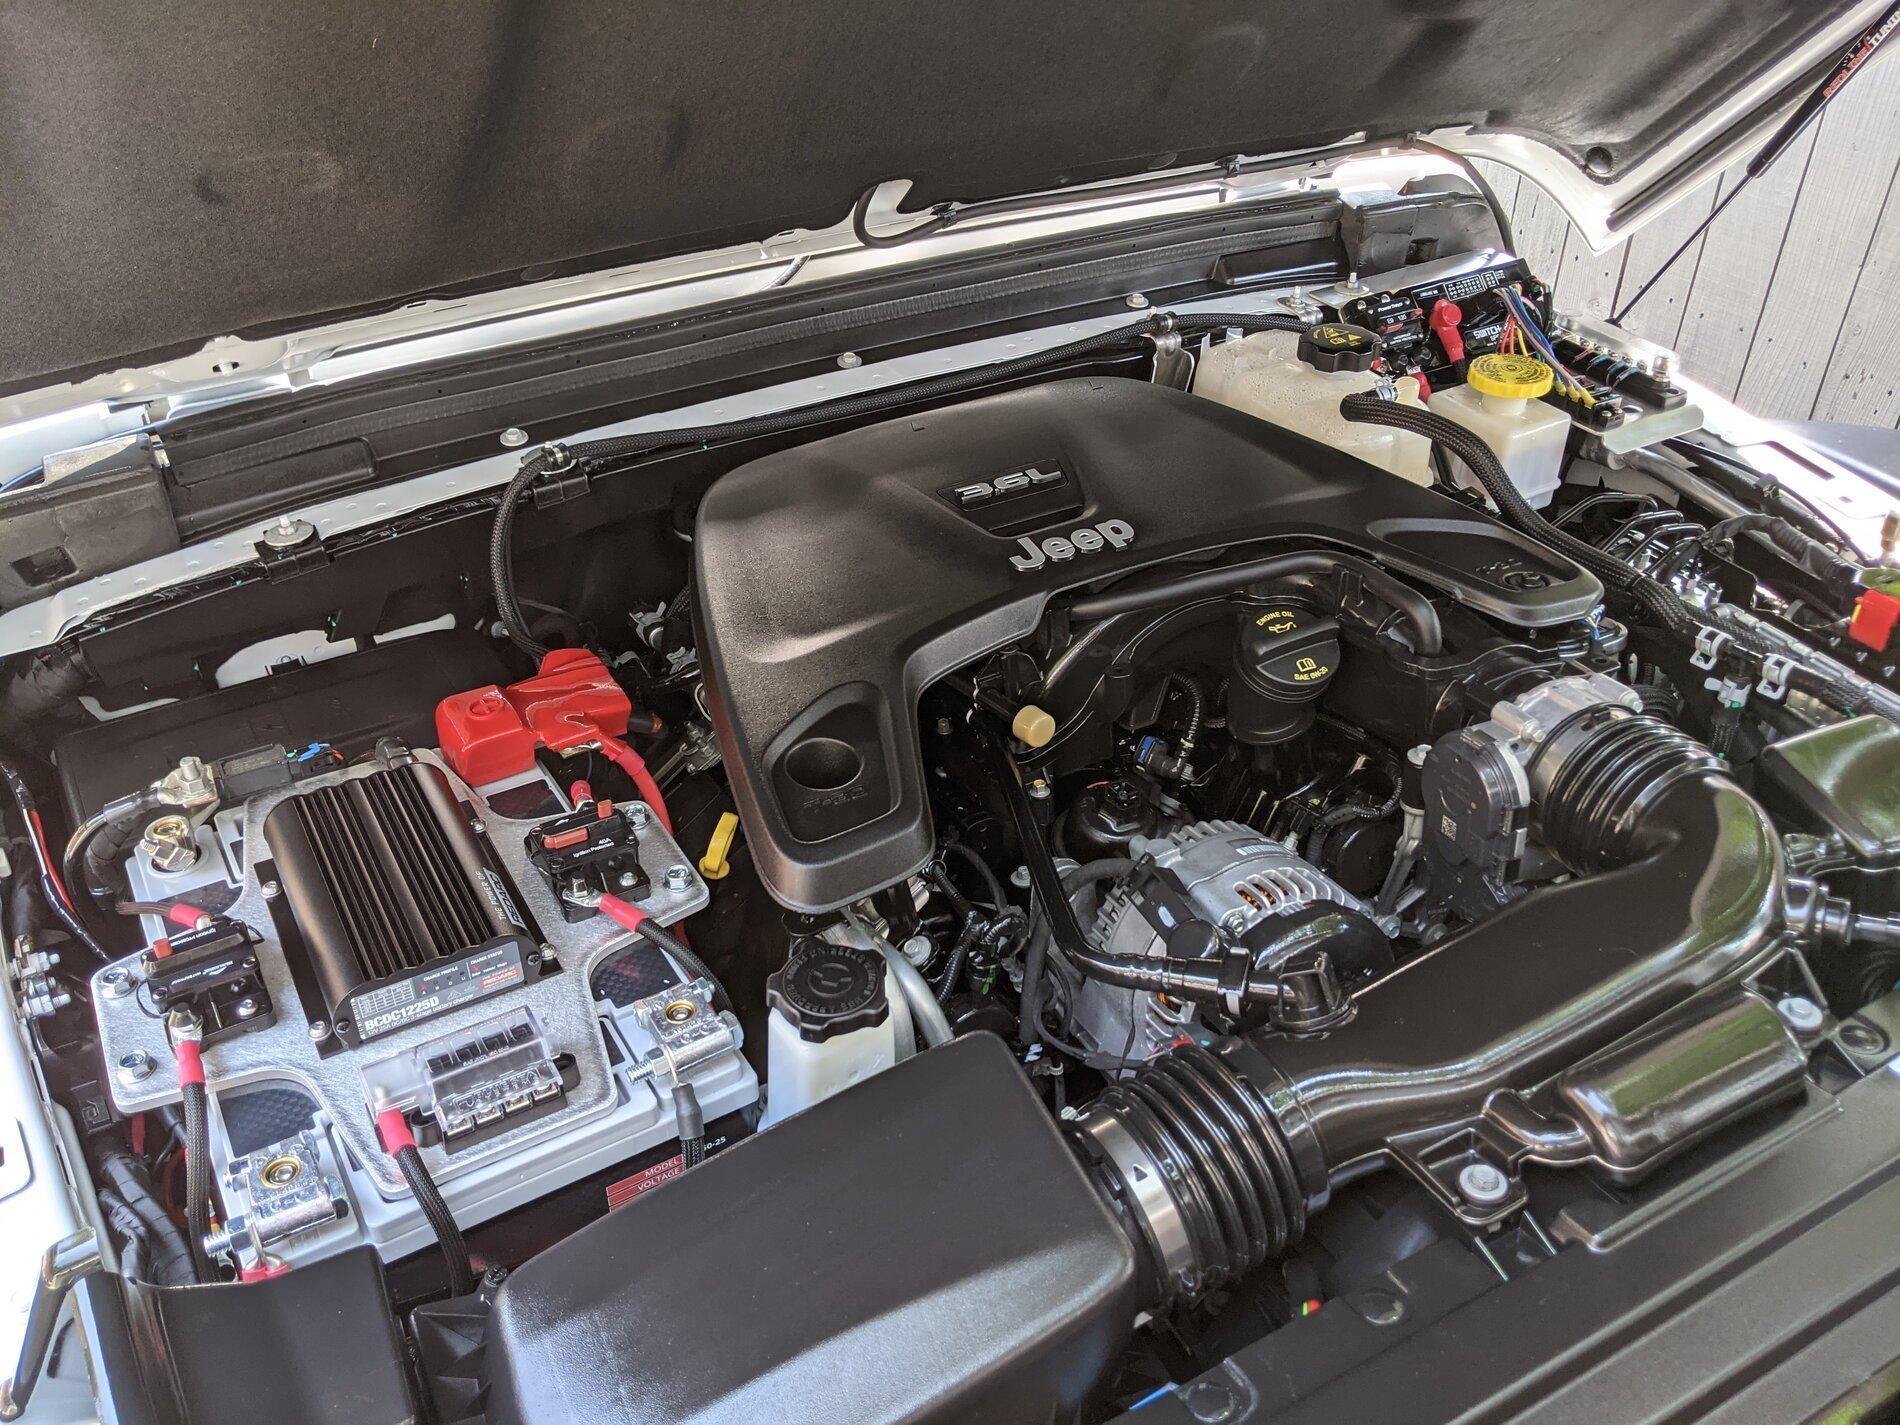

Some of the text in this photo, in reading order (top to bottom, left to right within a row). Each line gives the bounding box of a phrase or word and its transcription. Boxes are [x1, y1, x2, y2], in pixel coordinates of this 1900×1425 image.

[1008, 518, 1135, 573] Jeep
[1256, 611, 1281, 626] ENGINE
[1294, 673, 1310, 681] SAE
[573, 842, 615, 858] Ignition Protected
[476, 871, 506, 920] THE POWER OF
[470, 950, 503, 965] CHARGE STATUS
[423, 966, 459, 981] CHARGE PROFILE
[433, 1001, 452, 1013] battery
[452, 993, 474, 1006] charger
[364, 996, 440, 1031] BCDC1225D
[645, 1158, 678, 1177] MODEL
[637, 1168, 679, 1191] VOLTAGE
